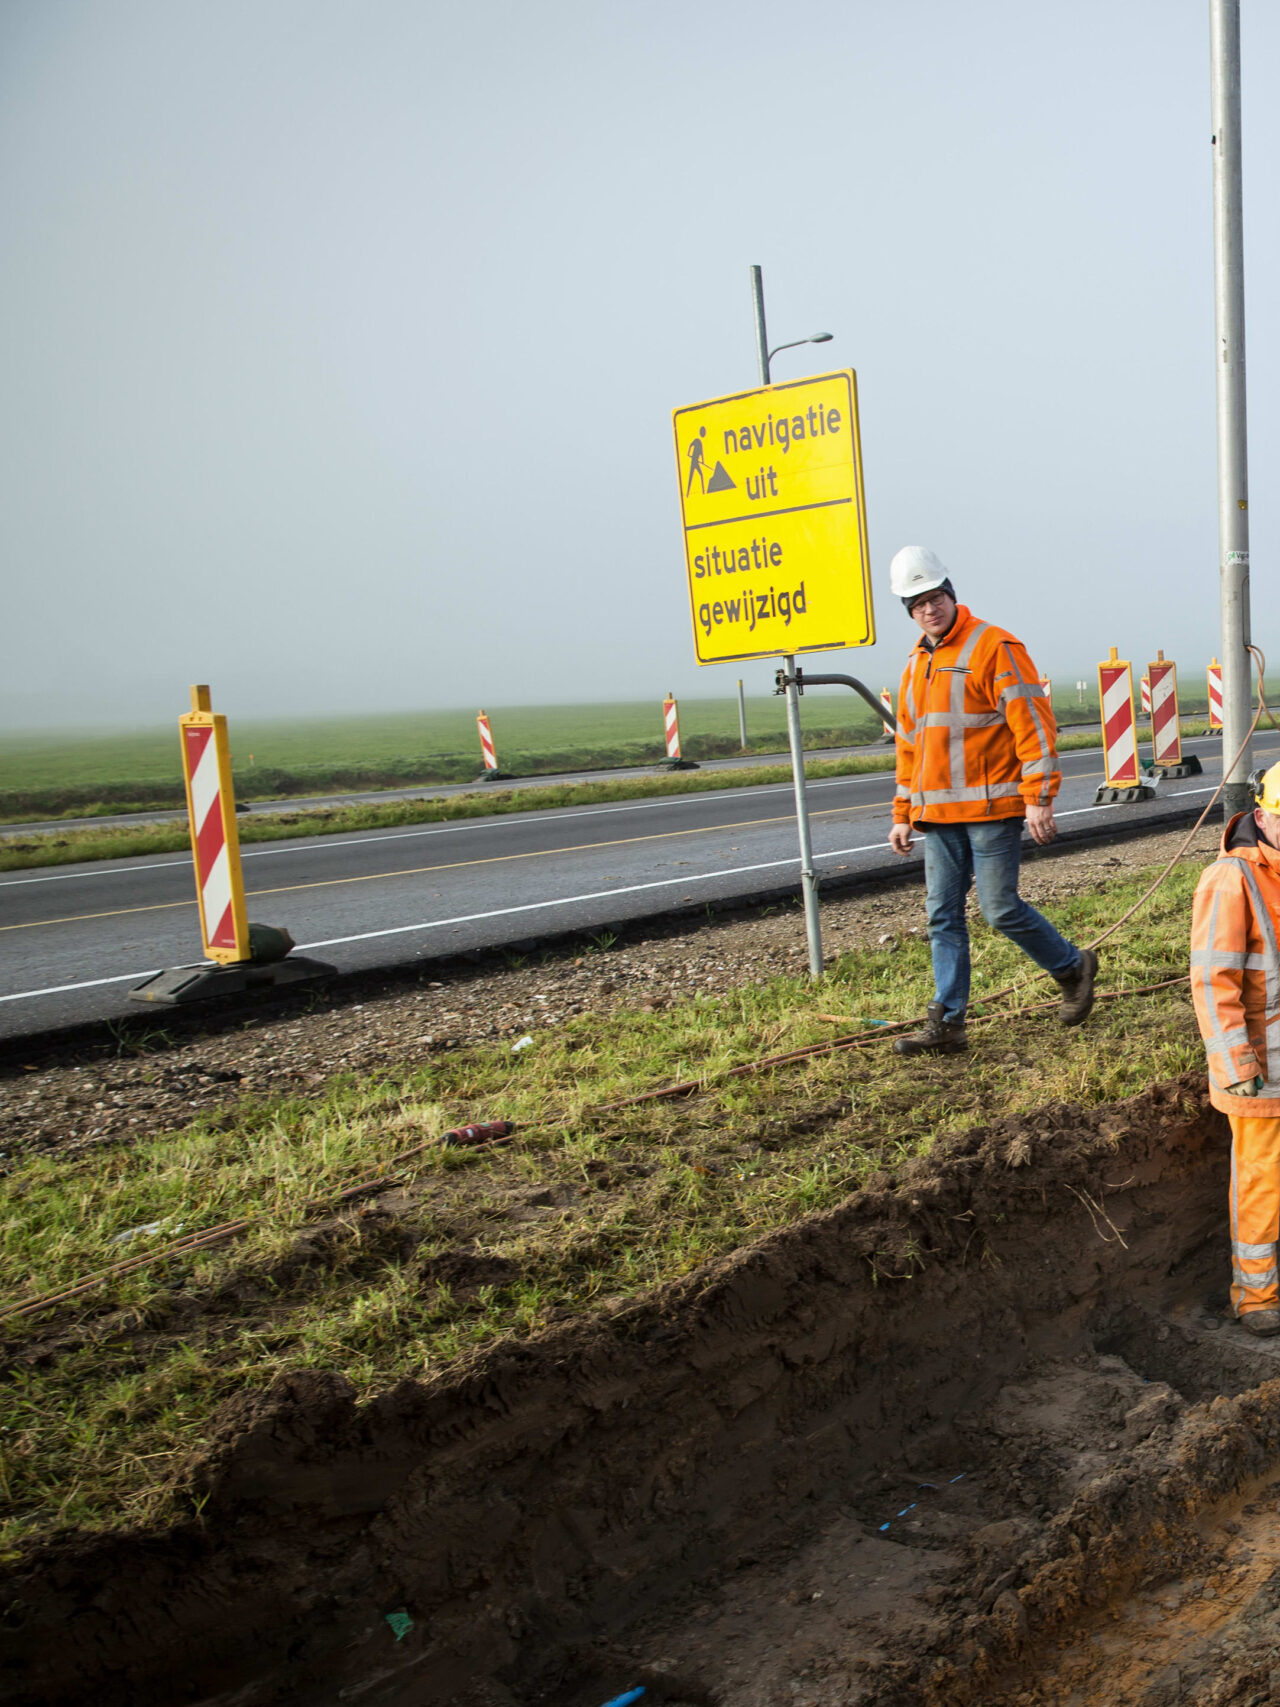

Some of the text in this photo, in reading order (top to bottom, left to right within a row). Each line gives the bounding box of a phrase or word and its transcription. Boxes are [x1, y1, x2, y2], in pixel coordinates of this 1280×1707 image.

[724, 403, 841, 455] navigatie
[745, 465, 778, 501] uit
[694, 537, 783, 579] situatie
[699, 581, 807, 637] gewijzigd
